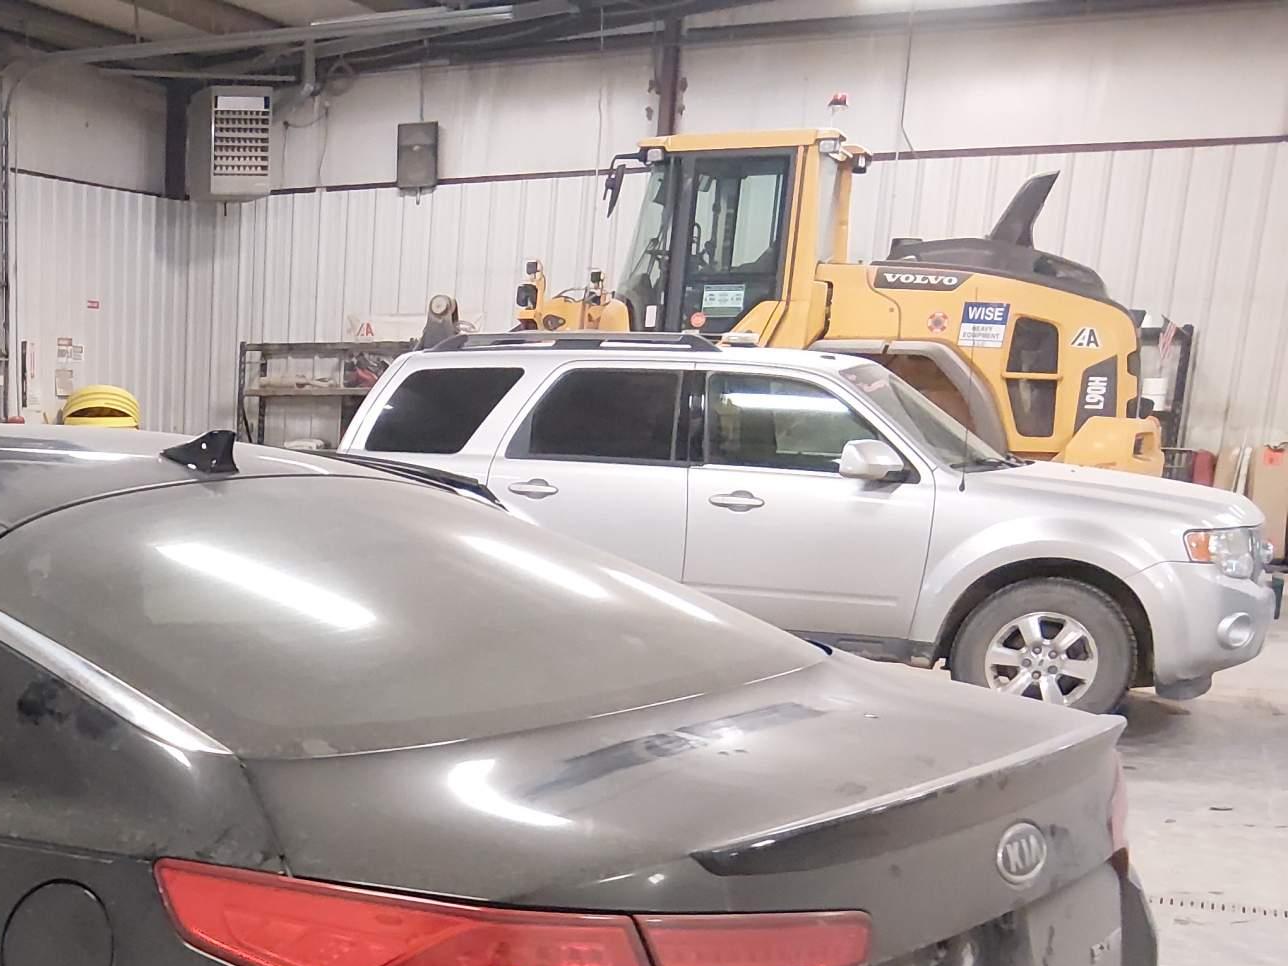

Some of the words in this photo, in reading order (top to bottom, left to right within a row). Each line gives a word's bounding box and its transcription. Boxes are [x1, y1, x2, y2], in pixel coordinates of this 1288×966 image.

[883, 272, 958, 286] VOLVO
[968, 306, 1005, 321] WISE
[1084, 376, 1108, 410] L90H
[1006, 834, 1041, 873] KIA
